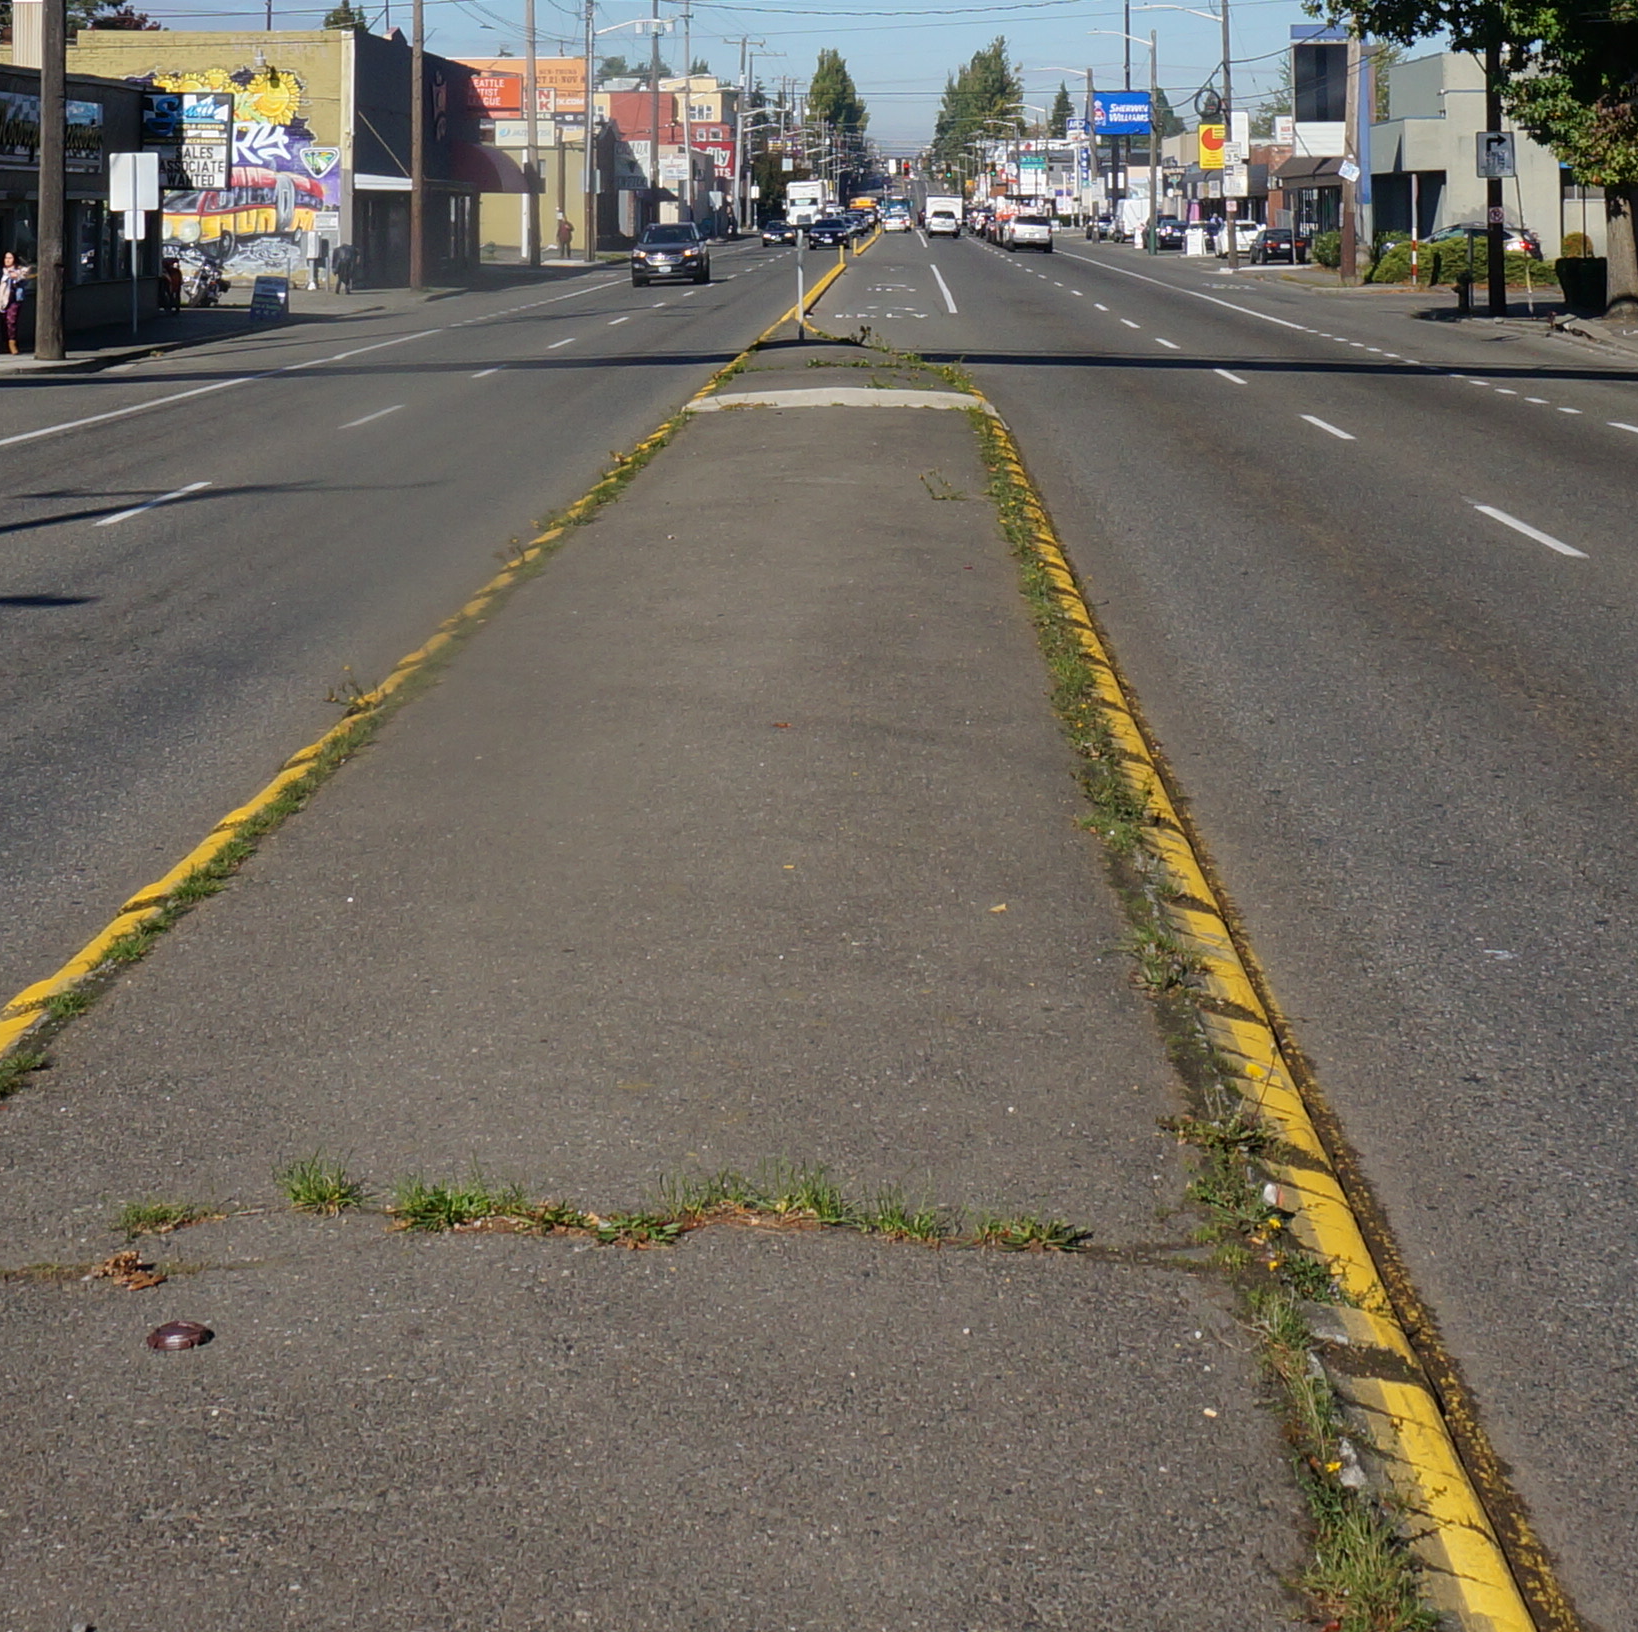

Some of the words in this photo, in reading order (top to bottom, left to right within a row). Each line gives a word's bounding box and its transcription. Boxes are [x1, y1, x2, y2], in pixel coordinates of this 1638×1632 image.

[470, 79, 505, 88] EATTLE
[1109, 103, 1149, 113] SHERWIN
[1109, 112, 1149, 122] WILLIAMS
[175, 147, 213, 159] SALES
[1226, 154, 1241, 162] 35
[159, 160, 224, 173] ASSOCIATE
[166, 174, 215, 186] WANTED
